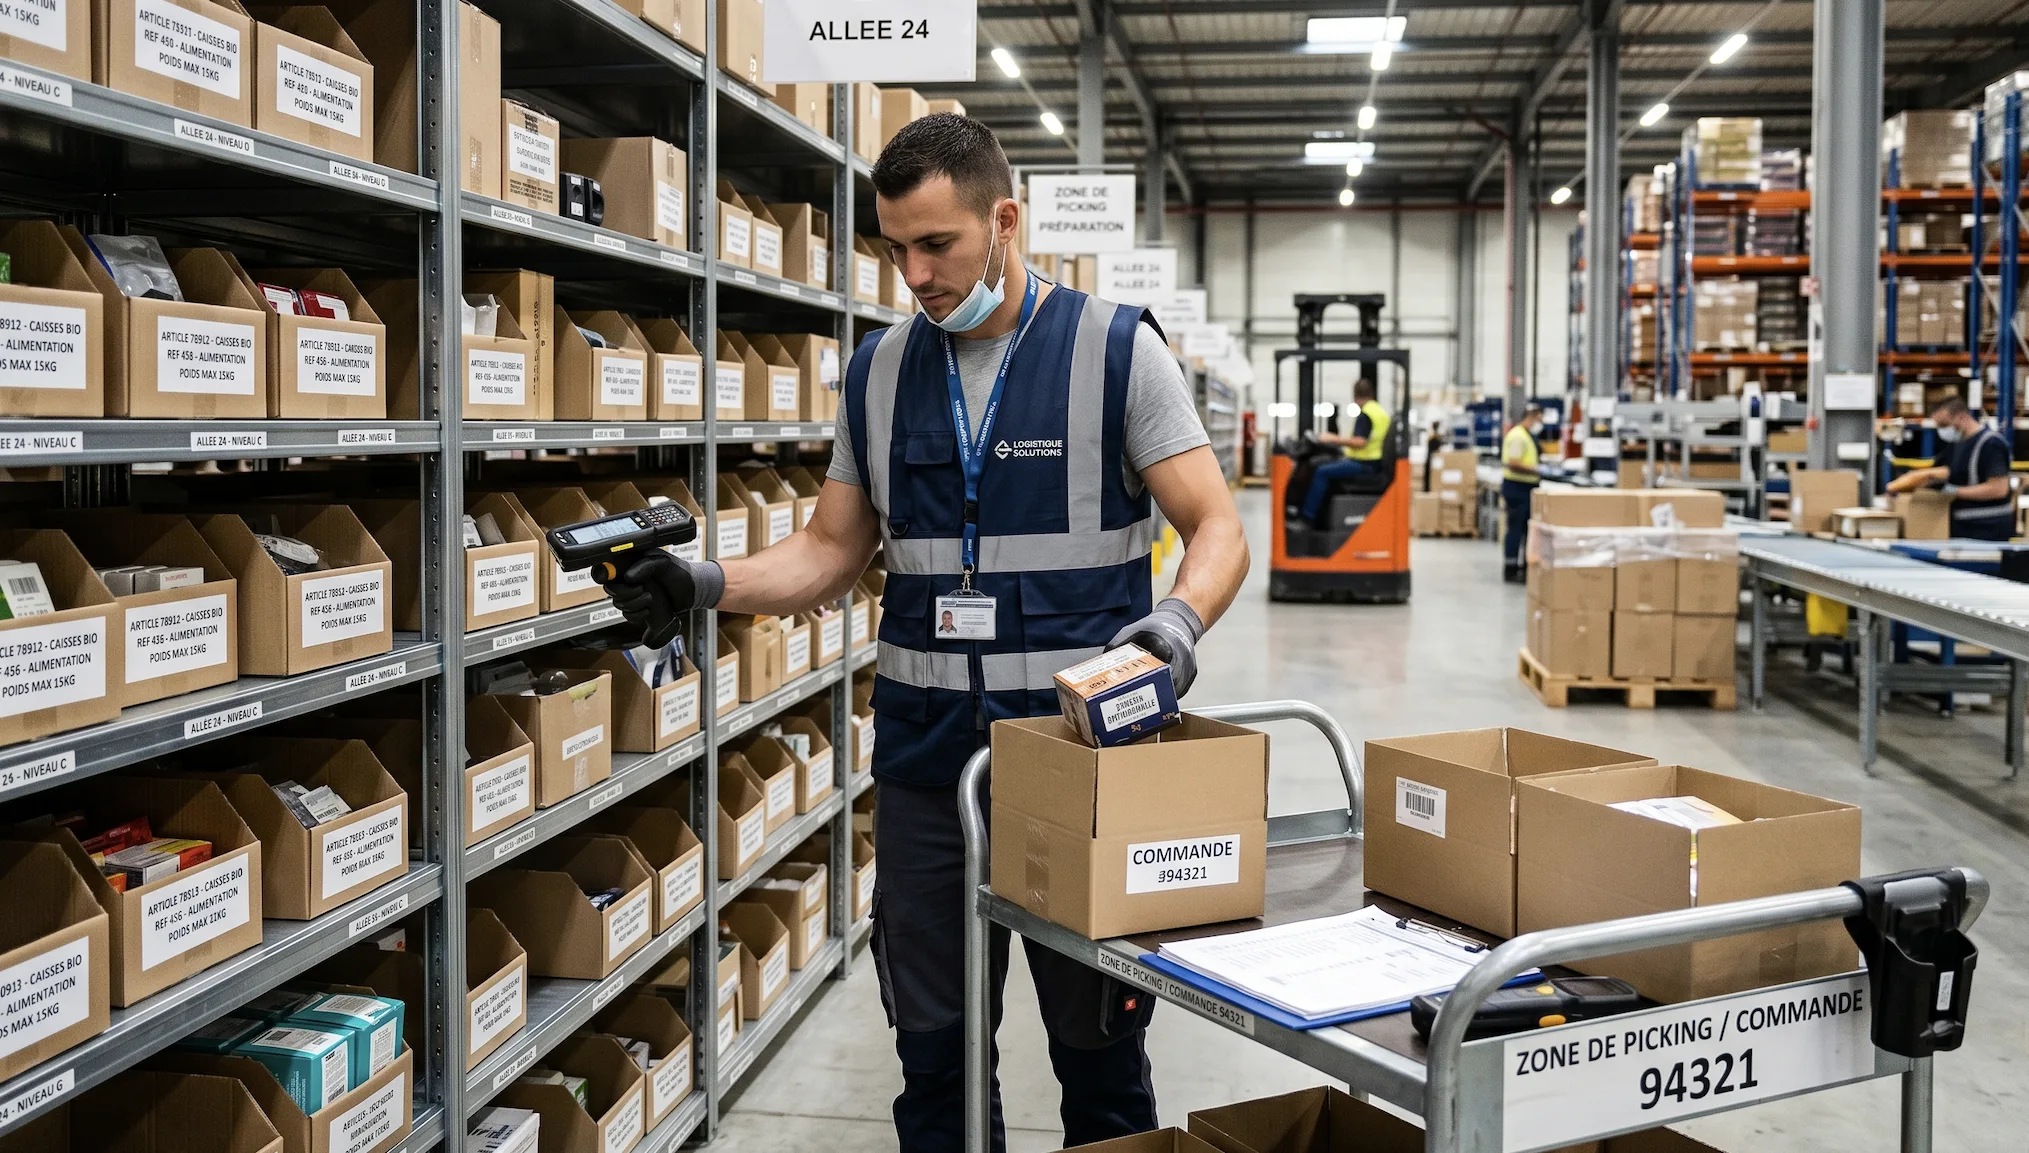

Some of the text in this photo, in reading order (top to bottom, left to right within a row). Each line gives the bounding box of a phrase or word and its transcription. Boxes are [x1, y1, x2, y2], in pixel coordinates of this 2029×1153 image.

[139, 10, 170, 29] ARTICLE
[197, 30, 225, 50] CAISSES
[226, 41, 238, 54] BIO
[809, 19, 930, 41] ALLEE 24
[144, 29, 159, 43] REF
[180, 42, 232, 69] ALIMENTATION
[159, 52, 220, 82] POIDS MAX 15KG
[14, 77, 51, 95] NIVEAU
[53, 86, 61, 97] C
[180, 125, 204, 140] ALLEE
[205, 131, 214, 142] 24
[218, 135, 243, 150] NIVEAU
[1055, 187, 1108, 198] ZONE DE
[1057, 202, 1107, 212] PICKING
[1039, 220, 1124, 232] PRÉPARATION
[29, 321, 64, 334] CAISSES
[66, 323, 81, 335] BIO
[161, 331, 189, 343] ARTICLE
[215, 336, 240, 347] CAISSES
[6, 339, 74, 353] ALIMENTATION
[167, 349, 180, 360] REF
[199, 352, 246, 364] ALIMENTATION
[9, 359, 32, 371] MAX
[34, 360, 57, 372] 15KG
[304, 355, 315, 365] REF
[331, 358, 370, 369] ALIMENTATION
[179, 368, 200, 379] POIDS
[202, 370, 217, 380] MAX
[333, 373, 346, 383] MAX
[14, 437, 26, 449] 24
[33, 437, 69, 448] NIVEAU
[70, 436, 77, 447] C
[196, 436, 217, 446] ALLEE
[218, 436, 227, 446] 24
[232, 436, 256, 446] NIVEAU
[1013, 448, 1062, 457] SOLUTIONS
[130, 607, 223, 632] ARTICLE 78912 CAISSES BIO
[310, 606, 321, 616] REF
[16, 641, 43, 656] 78912
[49, 635, 81, 650] CAISSES
[83, 632, 98, 644] BIO
[137, 636, 151, 648] REF
[169, 624, 218, 643] ALIMENTATION
[4, 653, 92, 677] 456 ALIMENTATION
[149, 651, 171, 664] POIDS
[172, 648, 189, 661] MAX
[2, 675, 76, 698] POIDS MAX 15KG
[213, 715, 222, 727] 24
[227, 710, 252, 724] NIVEAU
[252, 706, 258, 717] C
[23, 760, 59, 781] NIVEAU
[60, 758, 67, 770] C
[1132, 841, 1233, 865] COMMANDE
[204, 867, 243, 892] CAISSES BIO
[155, 917, 168, 931] REF
[188, 886, 239, 917] ALIMENTATION
[168, 919, 208, 943] POIDS MAX
[29, 962, 65, 986] CAISSES
[67, 954, 83, 969] BIO
[6, 976, 76, 1016] ALIMENTATION
[1100, 953, 1121, 971] ZONE
[1121, 962, 1132, 976] DE
[1133, 967, 1163, 991] PICKING
[1169, 983, 1218, 1016] COMMANDE
[11, 1013, 34, 1034] MAX
[36, 1003, 60, 1023] 15KG
[1516, 988, 1864, 1076] ZONE DE PICKING / COMMANDE
[1640, 1047, 1758, 1111] 94321
[17, 1083, 54, 1114] NIVEAU
